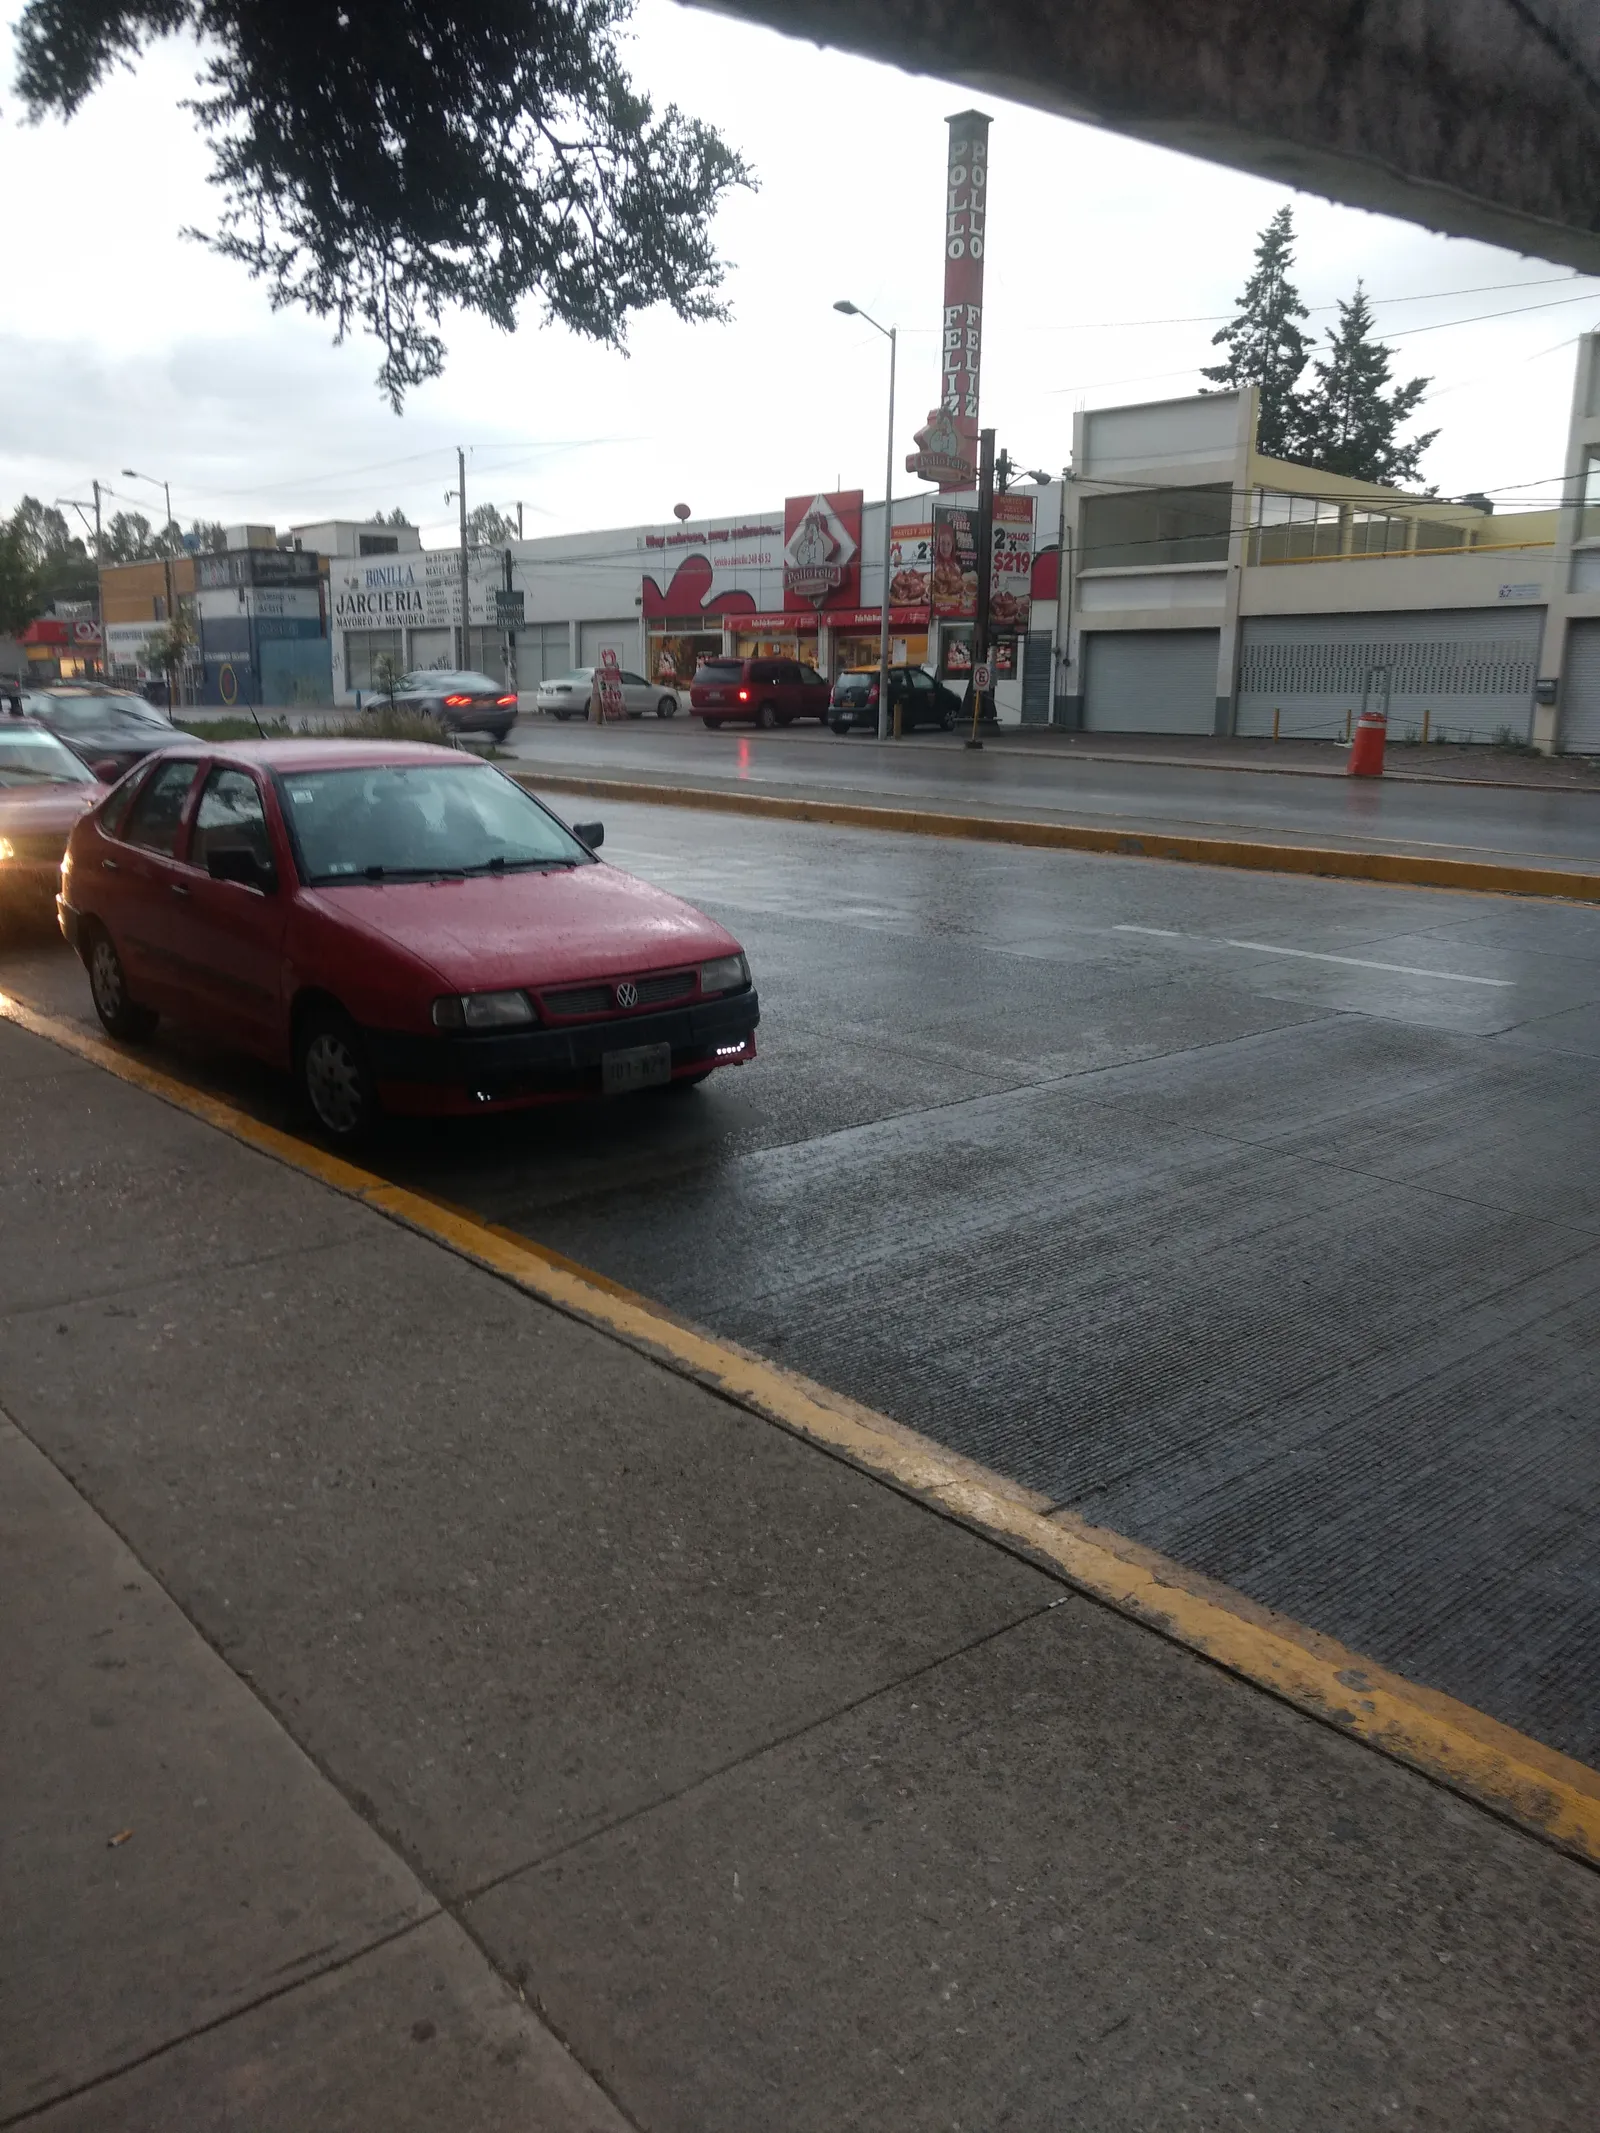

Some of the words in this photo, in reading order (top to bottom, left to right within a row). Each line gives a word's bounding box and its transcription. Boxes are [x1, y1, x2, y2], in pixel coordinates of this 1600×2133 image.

[948, 141, 968, 259] POLLO
[970, 141, 986, 259] POLLO
[944, 304, 963, 416] FELIZ
[965, 304, 980, 418] FELIZ
[920, 455, 946, 467] Pollo
[947, 458, 968, 471] Feliz
[918, 541, 928, 559] 2
[994, 527, 1005, 550] 2
[1006, 532, 1030, 542] POLLOS
[993, 549, 1031, 574] $219
[365, 563, 416, 589] BONILLA
[788, 568, 813, 584] Pollo
[814, 566, 837, 580] Feliz
[335, 590, 423, 615] JARCIERIA
[336, 616, 373, 628] MAYOREO
[376, 616, 382, 627] Y
[385, 613, 425, 627] MENUDEO
